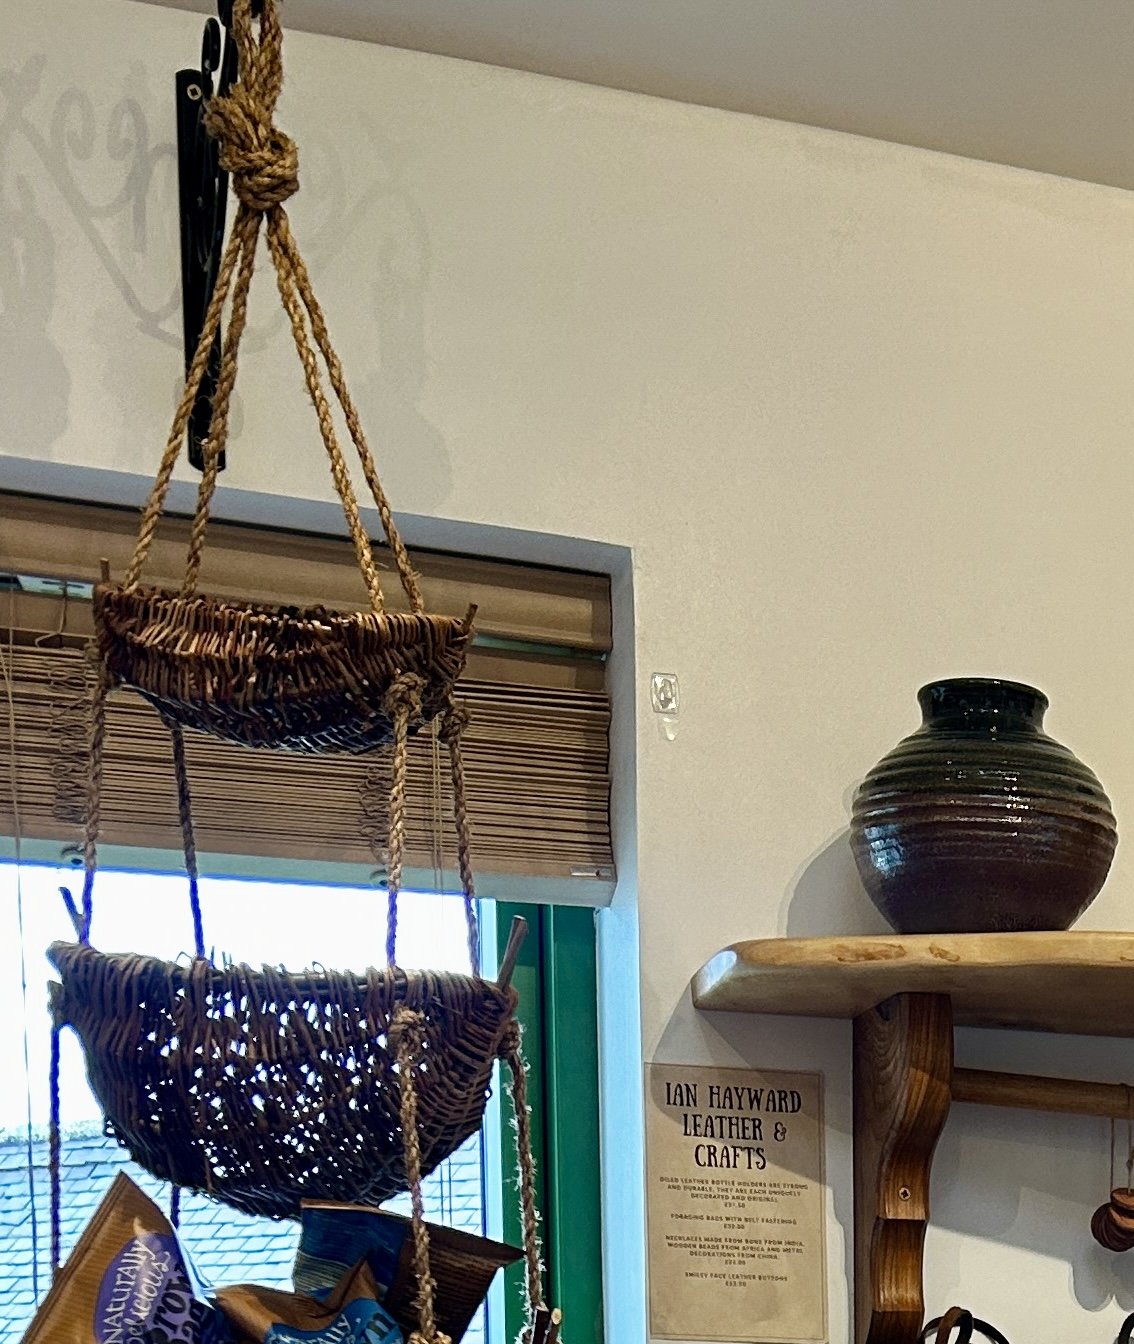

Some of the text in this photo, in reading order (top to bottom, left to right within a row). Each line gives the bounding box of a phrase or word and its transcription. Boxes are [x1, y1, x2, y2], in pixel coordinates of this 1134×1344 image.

[666, 1082, 802, 1114] IAN HAYWARD
[683, 1114, 786, 1142] LEATHER &
[694, 1144, 767, 1170] CRAFTS
